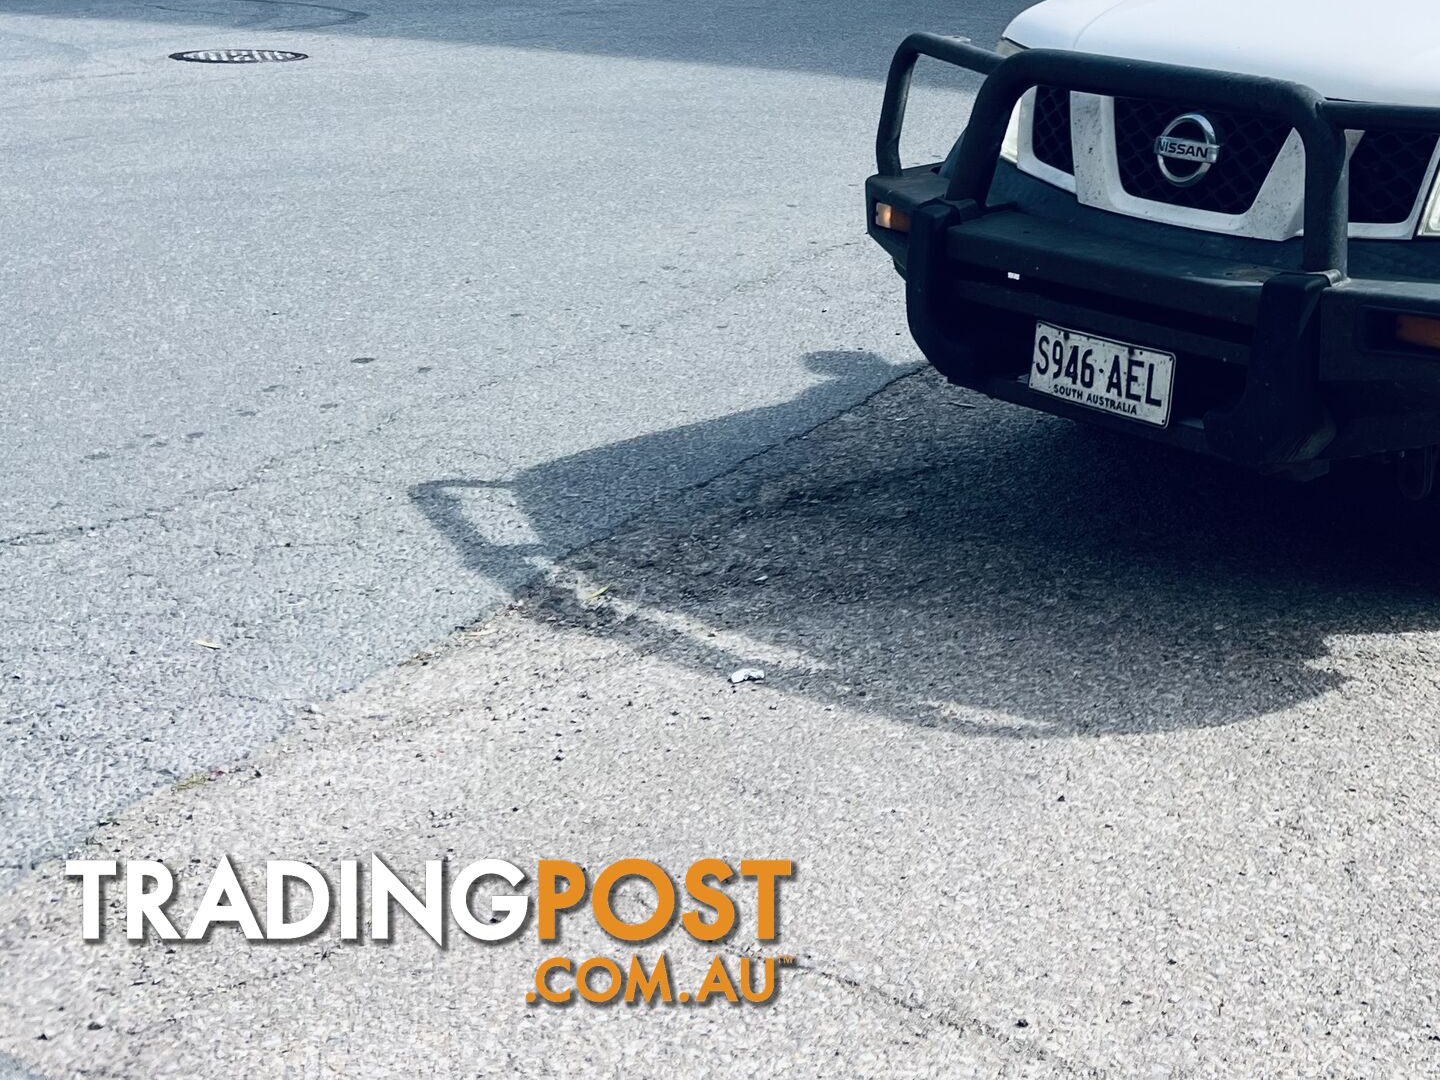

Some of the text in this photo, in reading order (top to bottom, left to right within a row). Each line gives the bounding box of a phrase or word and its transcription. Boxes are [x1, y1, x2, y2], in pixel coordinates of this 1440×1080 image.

[1159, 140, 1209, 159] NISSAN
[1053, 384, 1138, 416] SOUTH AUSTRALIA
